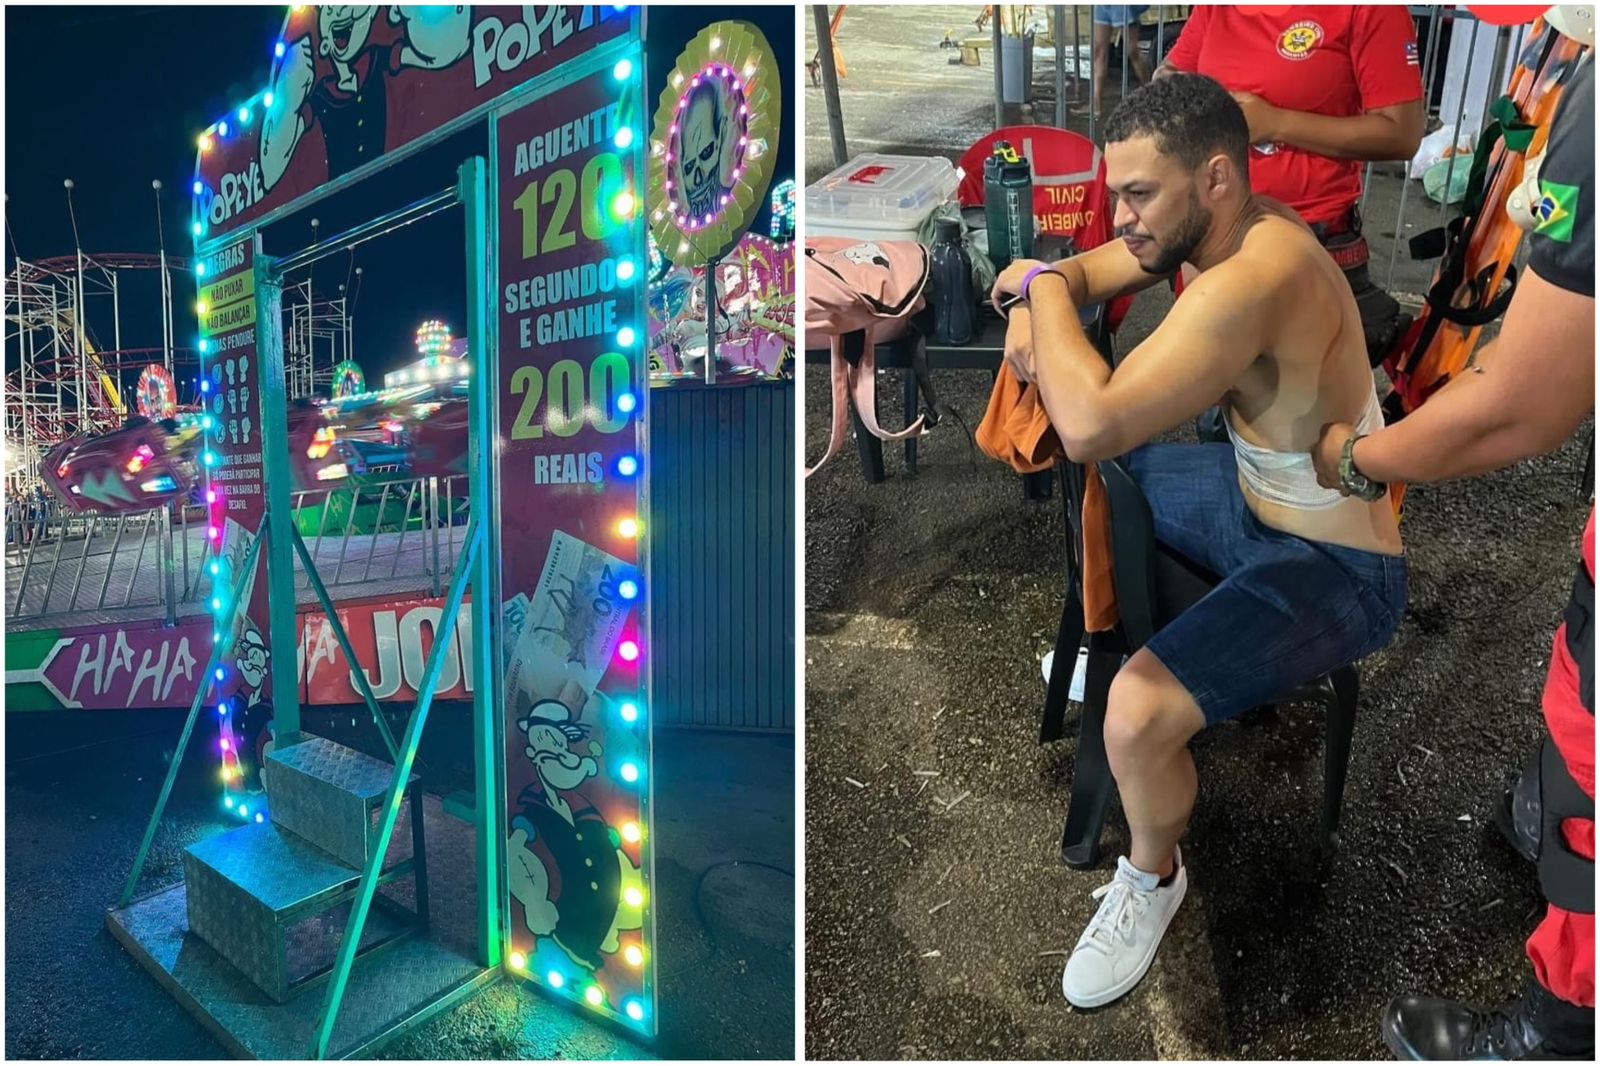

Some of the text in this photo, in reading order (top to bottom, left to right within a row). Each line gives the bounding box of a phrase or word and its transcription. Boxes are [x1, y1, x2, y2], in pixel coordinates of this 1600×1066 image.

[473, 5, 618, 87] POPE
[200, 157, 264, 237] POPEYE
[513, 152, 623, 260] 120
[1045, 185, 1085, 204] CIVIL
[211, 279, 243, 302] NÃO PUXAR
[207, 304, 251, 329] NÃO BALANÇAR
[227, 328, 255, 350] PENDURE
[520, 300, 616, 348] E GANHE
[510, 352, 630, 440] 200
[534, 452, 604, 484] REAIS
[593, 564, 615, 617] 200
[350, 602, 473, 699] JO
